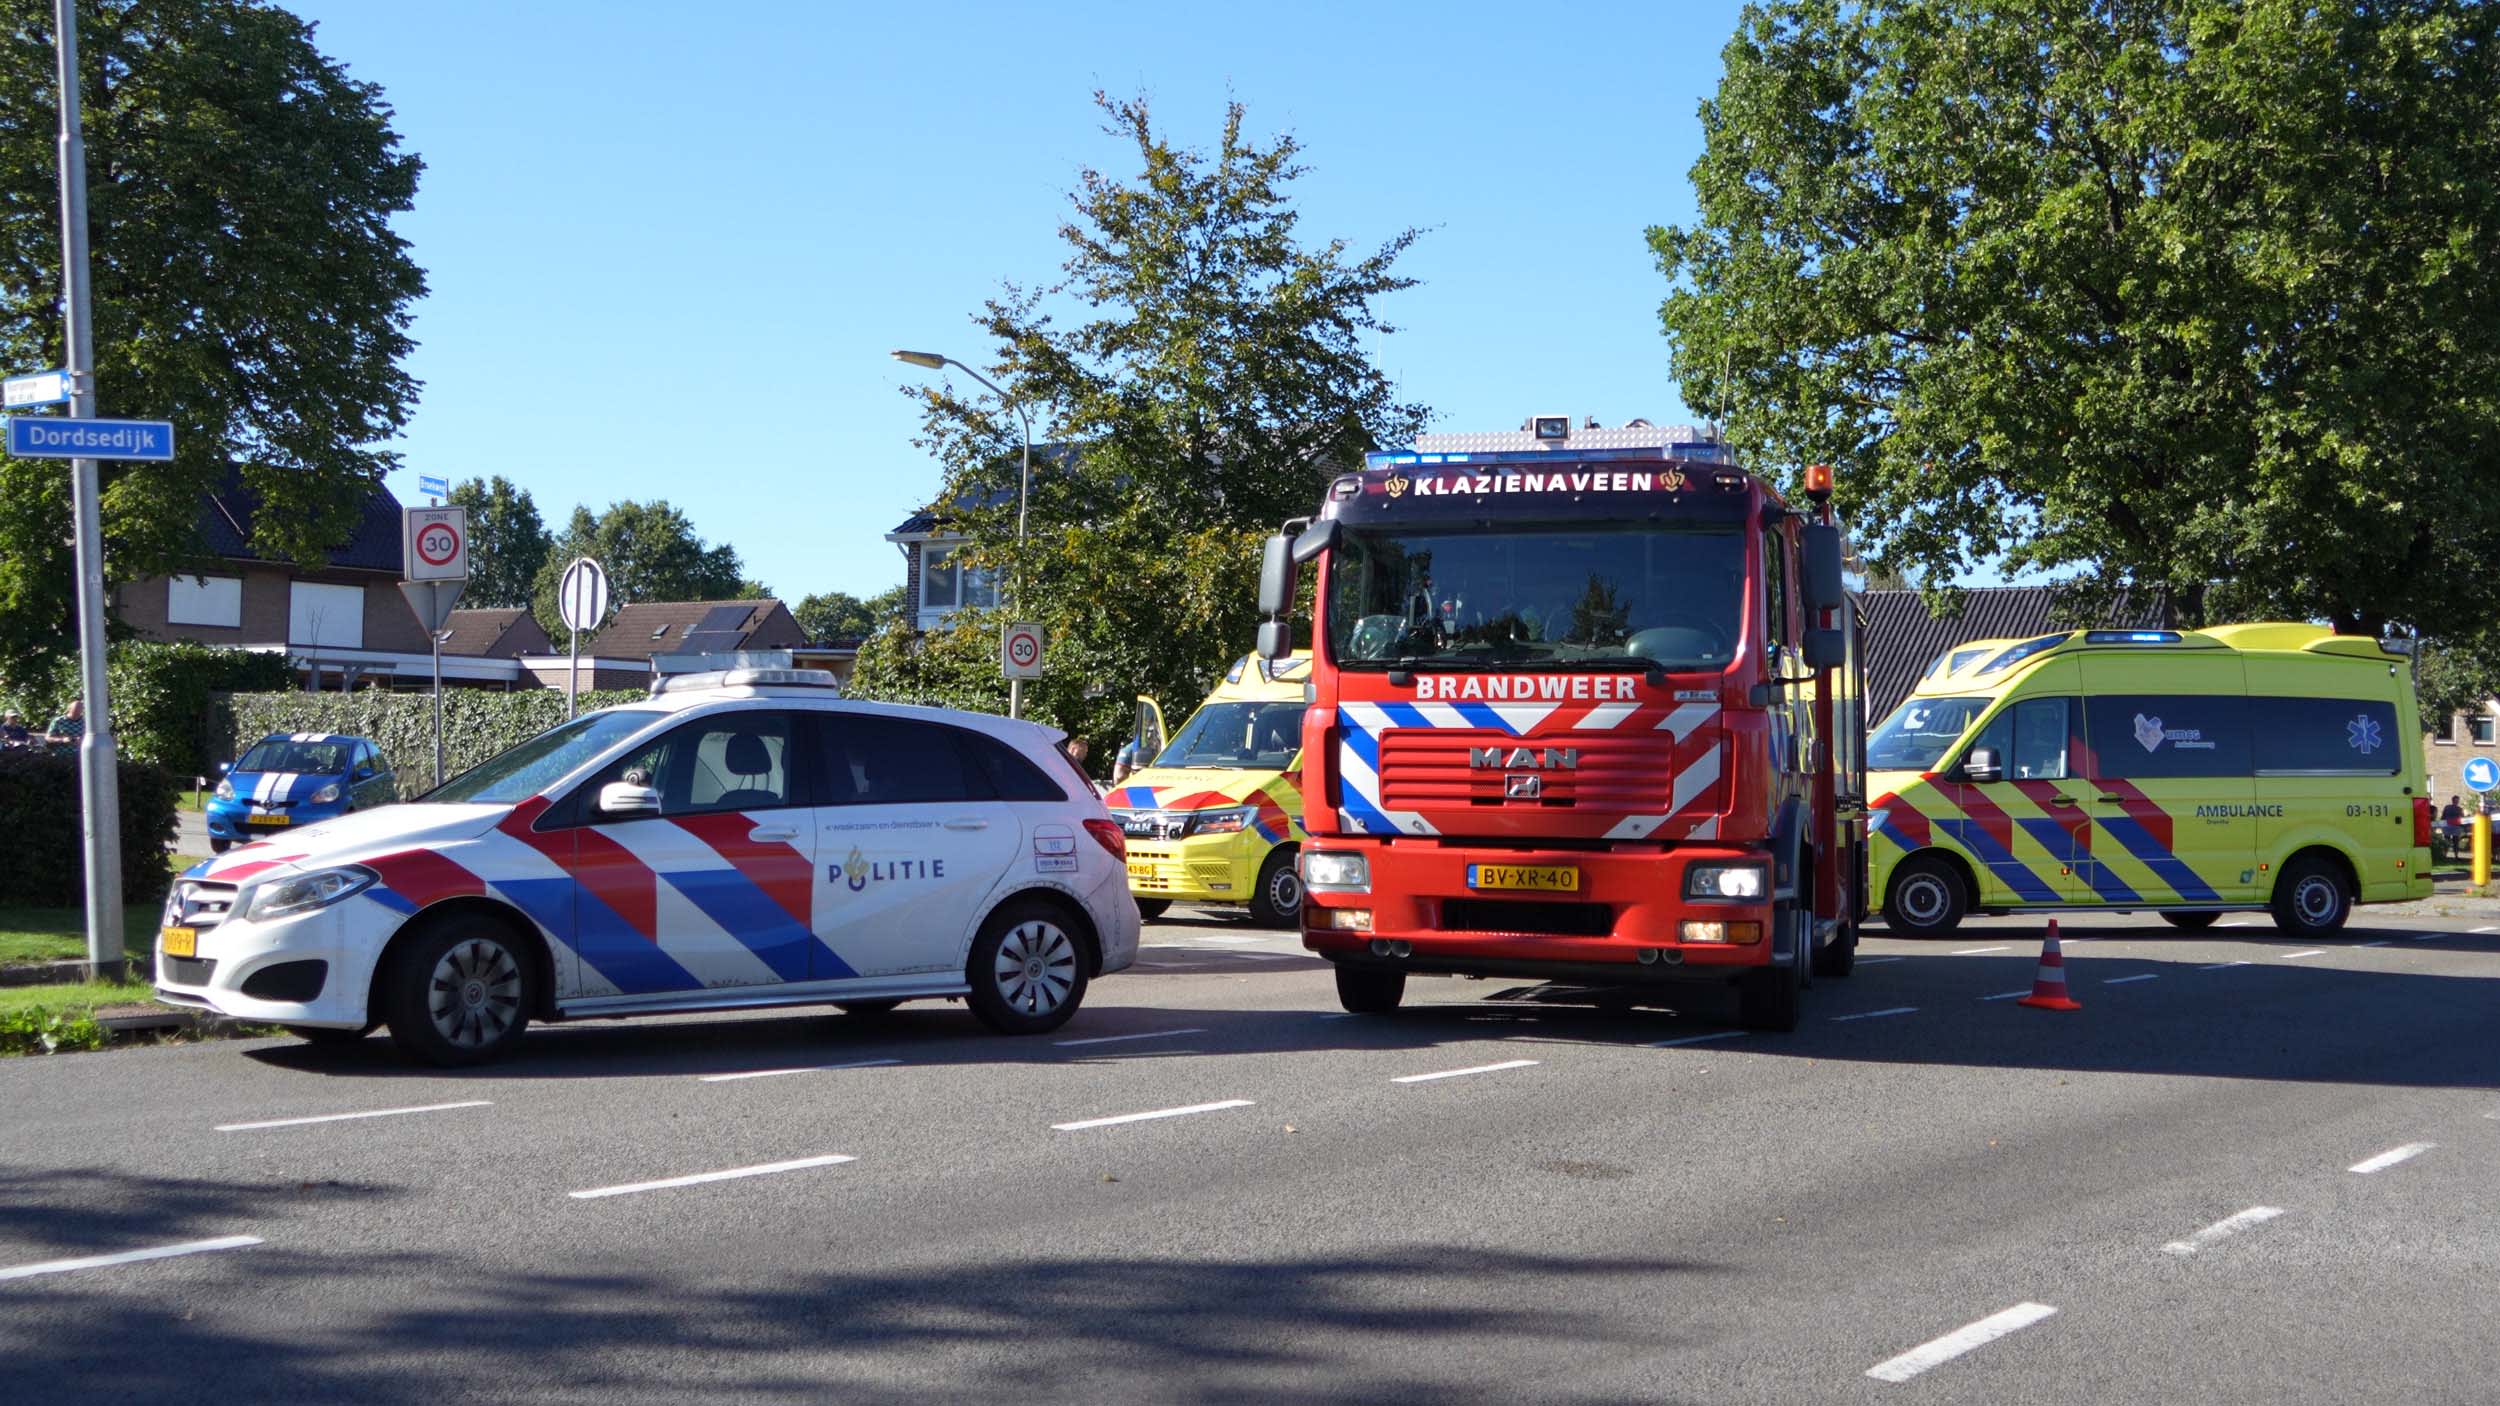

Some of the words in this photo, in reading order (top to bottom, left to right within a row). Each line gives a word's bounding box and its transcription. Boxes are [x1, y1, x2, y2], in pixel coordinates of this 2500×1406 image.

[30, 427, 154, 452] Dordsedijk
[1414, 473, 1652, 496] KLAZIENAVEEN
[425, 513, 448, 521] ZONE
[425, 537, 451, 552] 30
[1015, 644, 1032, 656] 30
[1416, 677, 1636, 699] BRANDWEER
[1470, 747, 1577, 768] MAN
[2196, 805, 2283, 817] AMBULANCE
[2347, 805, 2389, 817] 03-131
[828, 859, 945, 892] POLITIE
[1484, 868, 1572, 887] BV-XR-40
